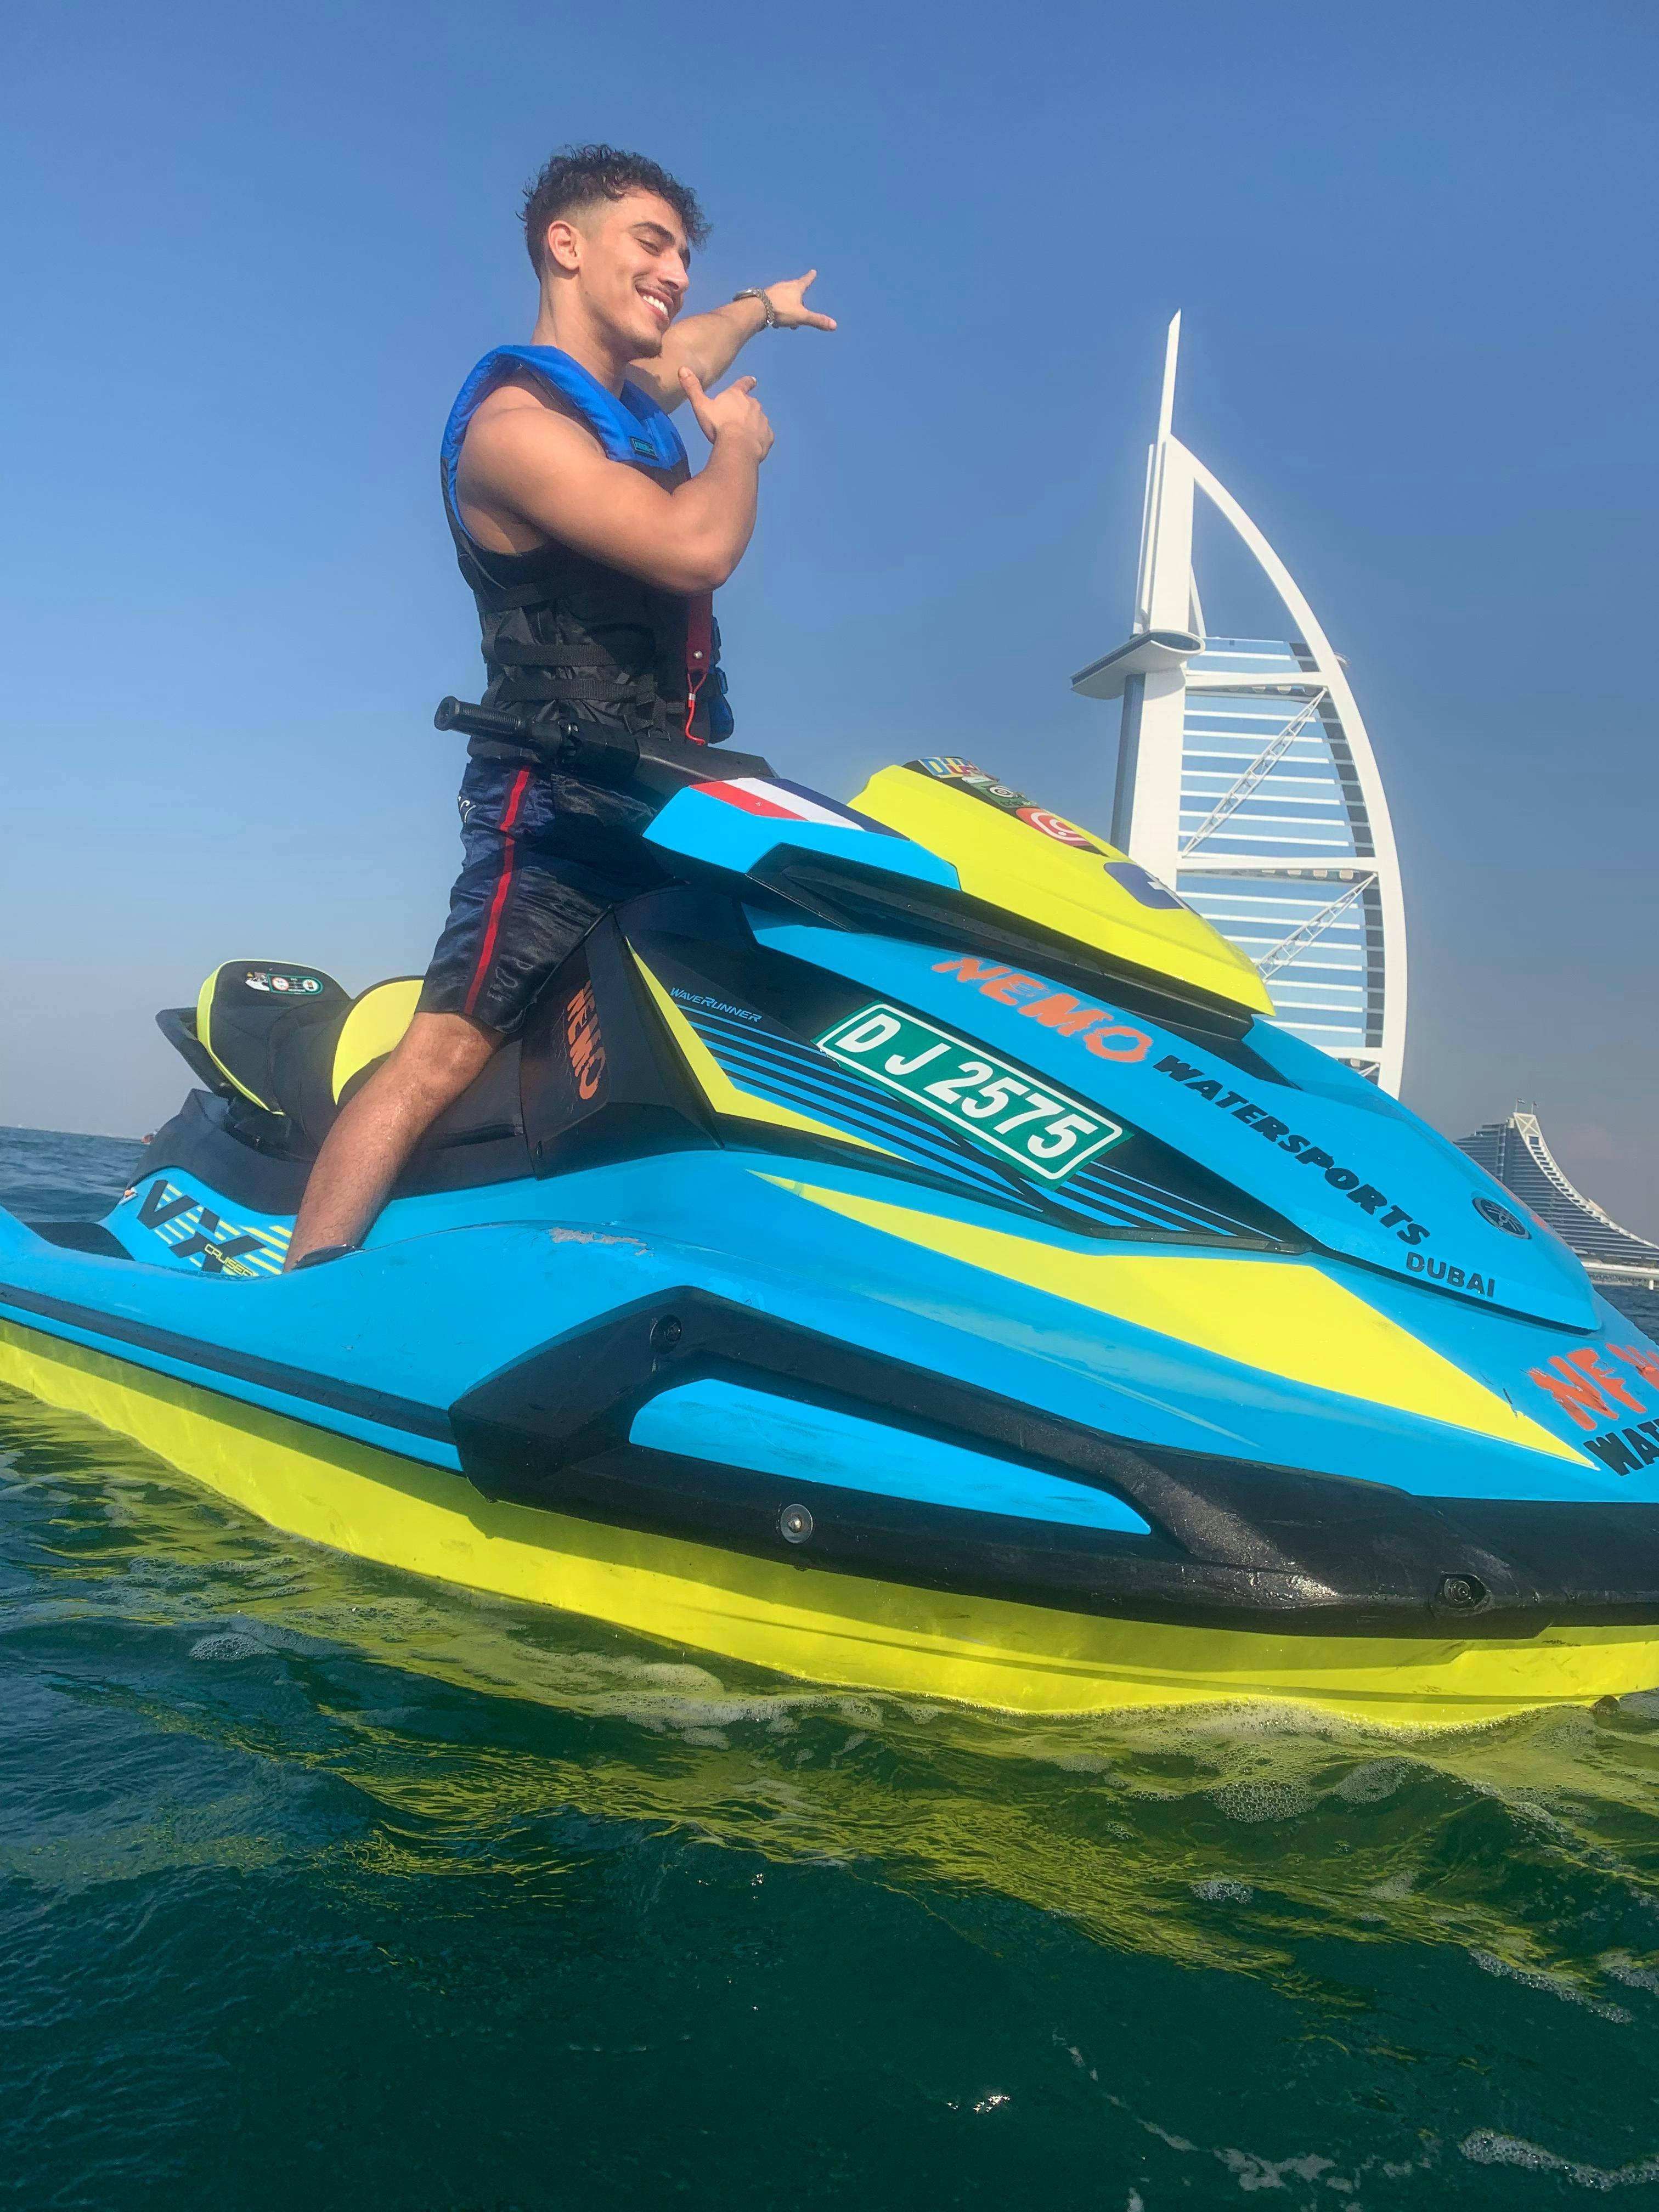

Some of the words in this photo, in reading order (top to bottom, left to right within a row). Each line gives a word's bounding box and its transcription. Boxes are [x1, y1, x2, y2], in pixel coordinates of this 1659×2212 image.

[924, 1060, 1098, 1159] 2575
[932, 957, 1154, 1063] NEMO
[1153, 1054, 1431, 1246] WATERSPORTS
[1406, 1251, 1496, 1299] DUBAI
